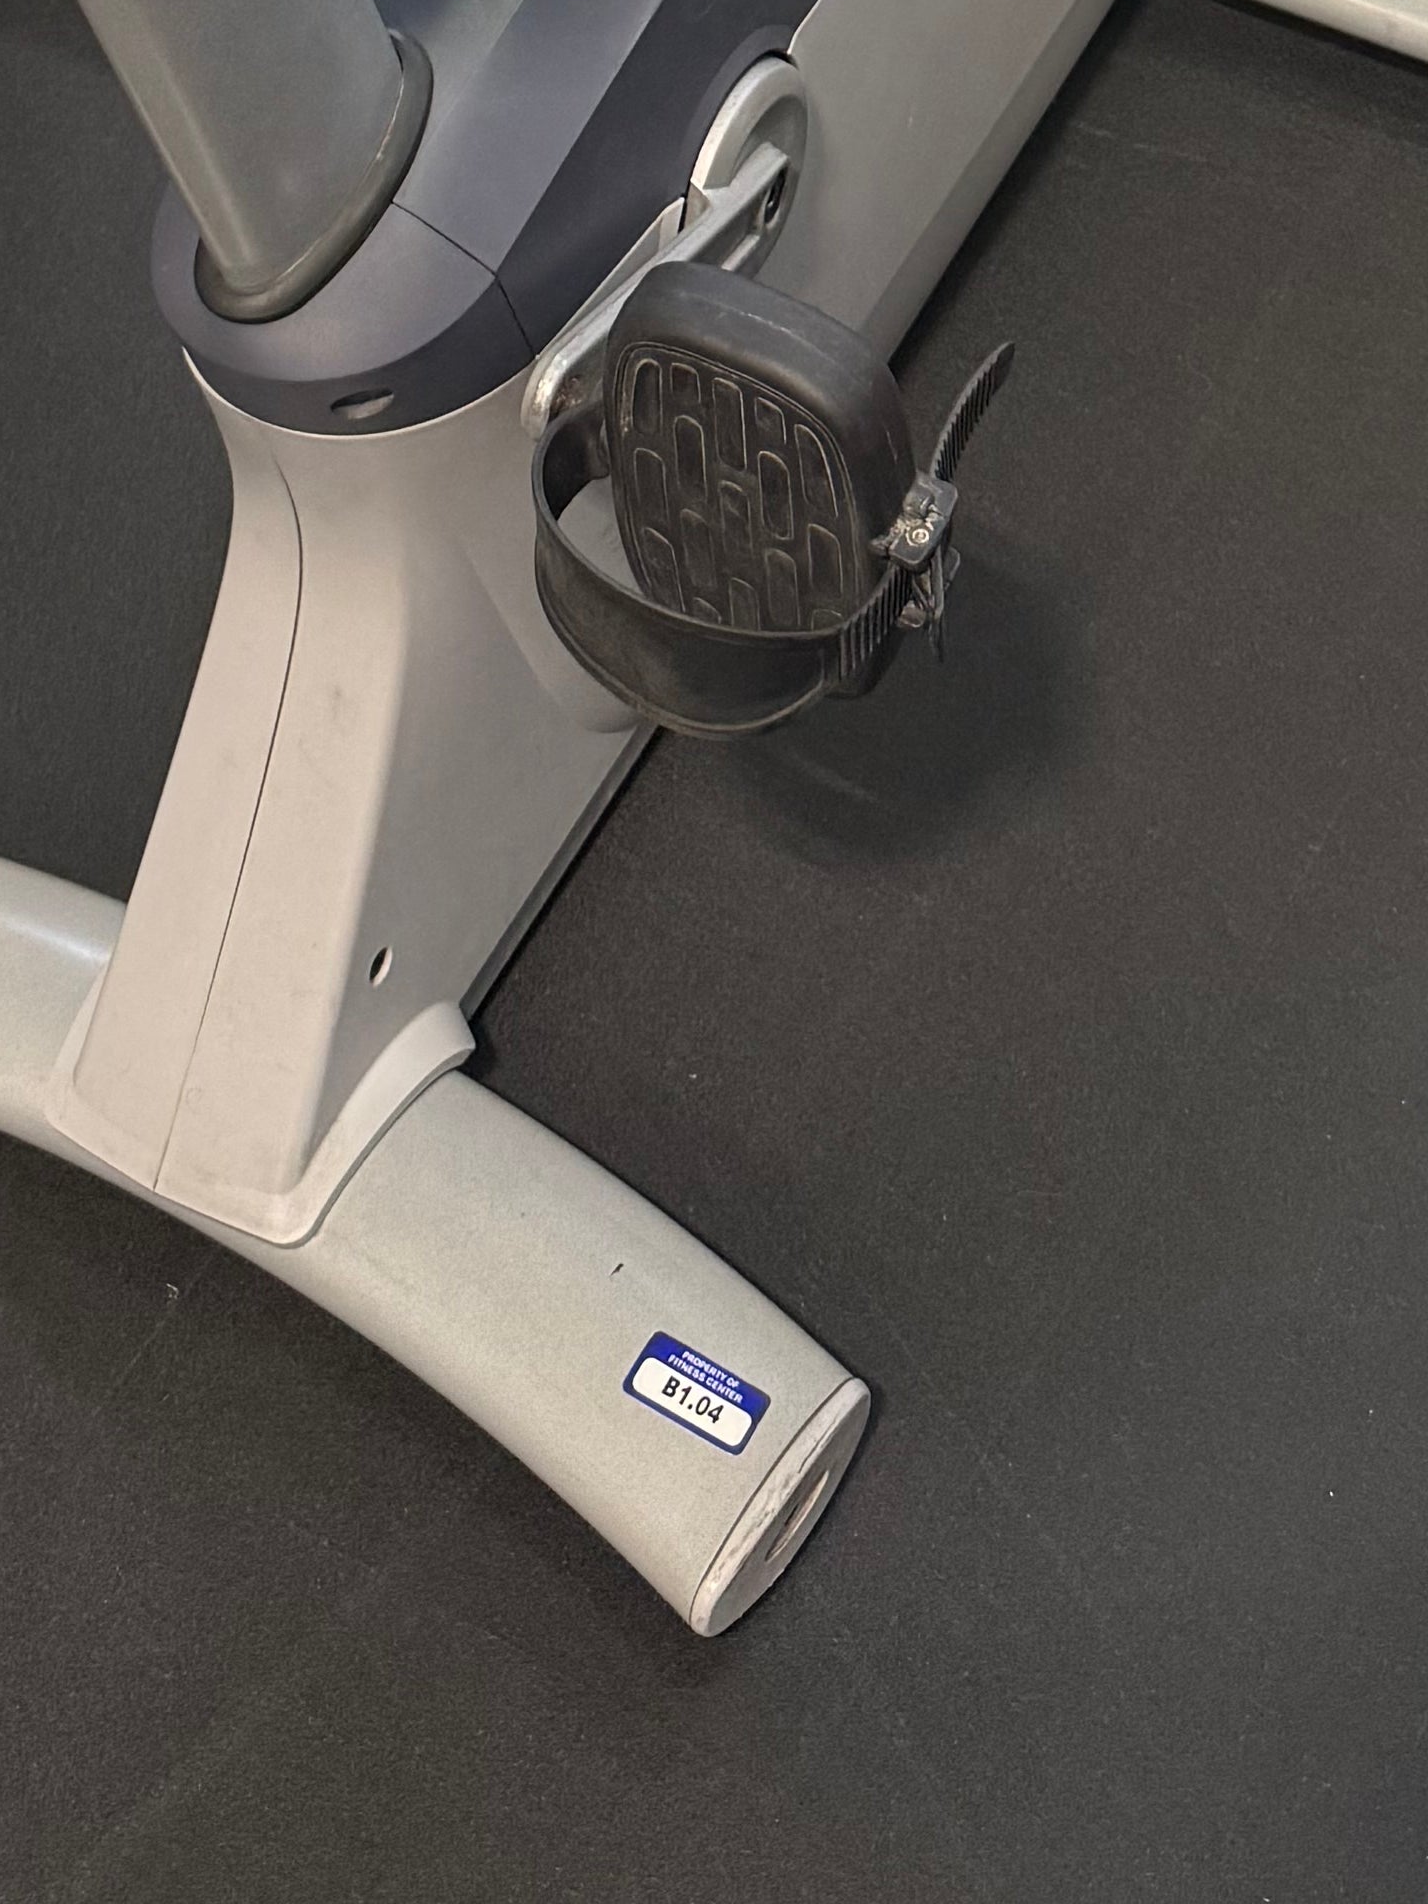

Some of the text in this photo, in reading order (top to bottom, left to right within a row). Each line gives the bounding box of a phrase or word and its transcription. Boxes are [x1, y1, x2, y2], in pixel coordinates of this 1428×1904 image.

[668, 1354, 744, 1404] FITNESS CENTER
[682, 1351, 740, 1388] PROPERTY OF
[661, 1376, 725, 1424] B1.04
